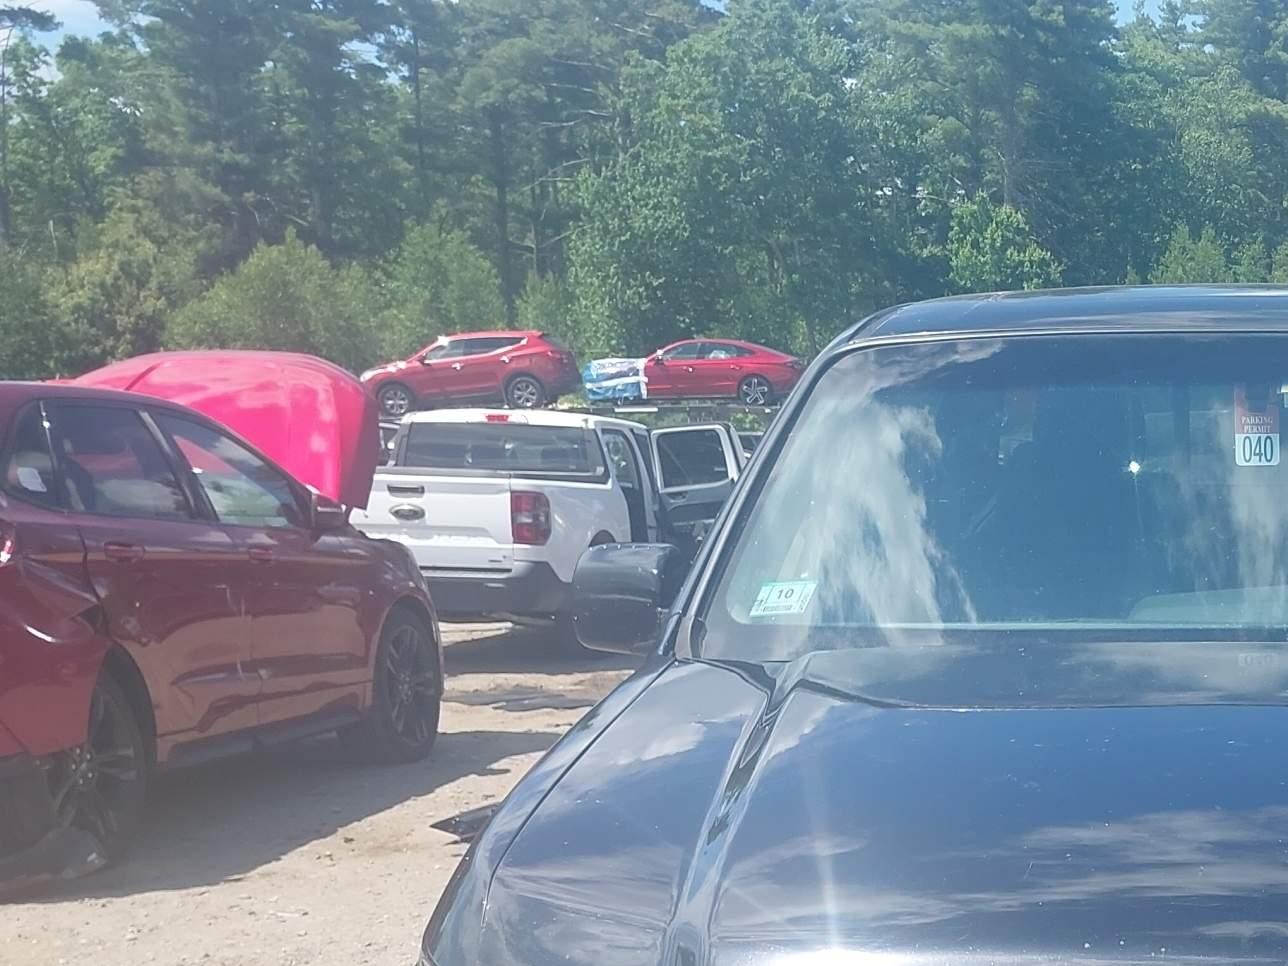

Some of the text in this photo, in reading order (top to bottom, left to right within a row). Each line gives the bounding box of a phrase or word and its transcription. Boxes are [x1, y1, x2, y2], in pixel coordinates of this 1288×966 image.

[1241, 415, 1273, 424] PARKING
[1243, 425, 1271, 433] PERMIT
[1242, 436, 1274, 463] 040
[777, 588, 795, 600] 10
